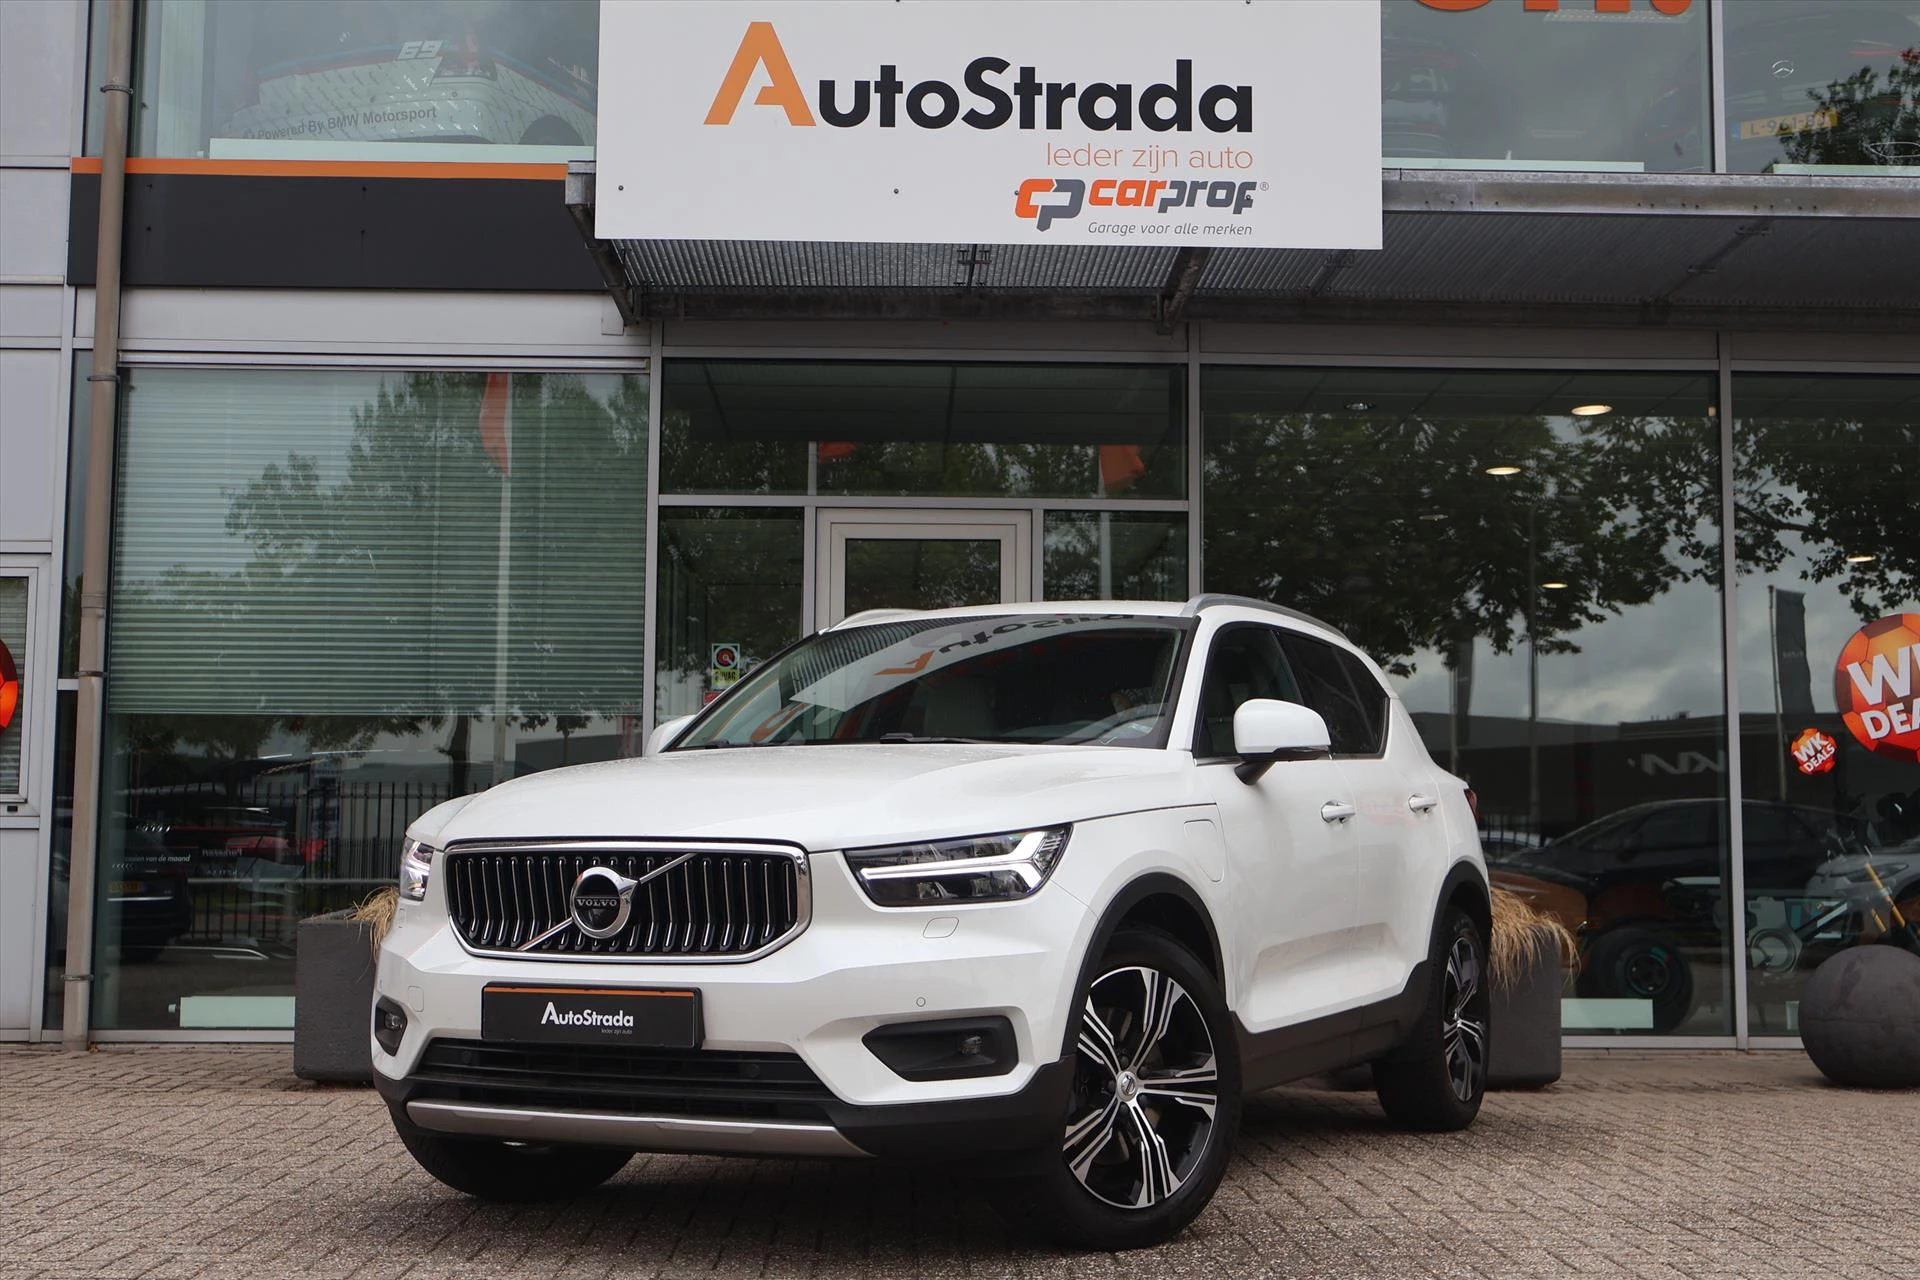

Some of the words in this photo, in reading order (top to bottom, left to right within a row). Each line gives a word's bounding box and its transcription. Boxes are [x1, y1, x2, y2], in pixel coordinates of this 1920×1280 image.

[703, 21, 1253, 133] AutoStrada
[257, 123, 304, 141] Powered
[308, 119, 324, 134] By
[327, 113, 360, 130] BMW
[363, 106, 438, 125] Motorsport
[1047, 142, 1123, 167] Ieder
[1132, 144, 1178, 174] zijn
[1188, 146, 1253, 169] auto
[1087, 221, 1136, 237] Garage
[1140, 223, 1170, 235] voor
[1174, 221, 1199, 236] alle
[1202, 222, 1252, 236] merken
[1794, 732, 1829, 763] WK
[1803, 743, 1835, 772] DEALS
[167, 854, 191, 862] maand
[576, 899, 618, 907] VOLVO
[541, 1001, 634, 1027] AutoStrada
